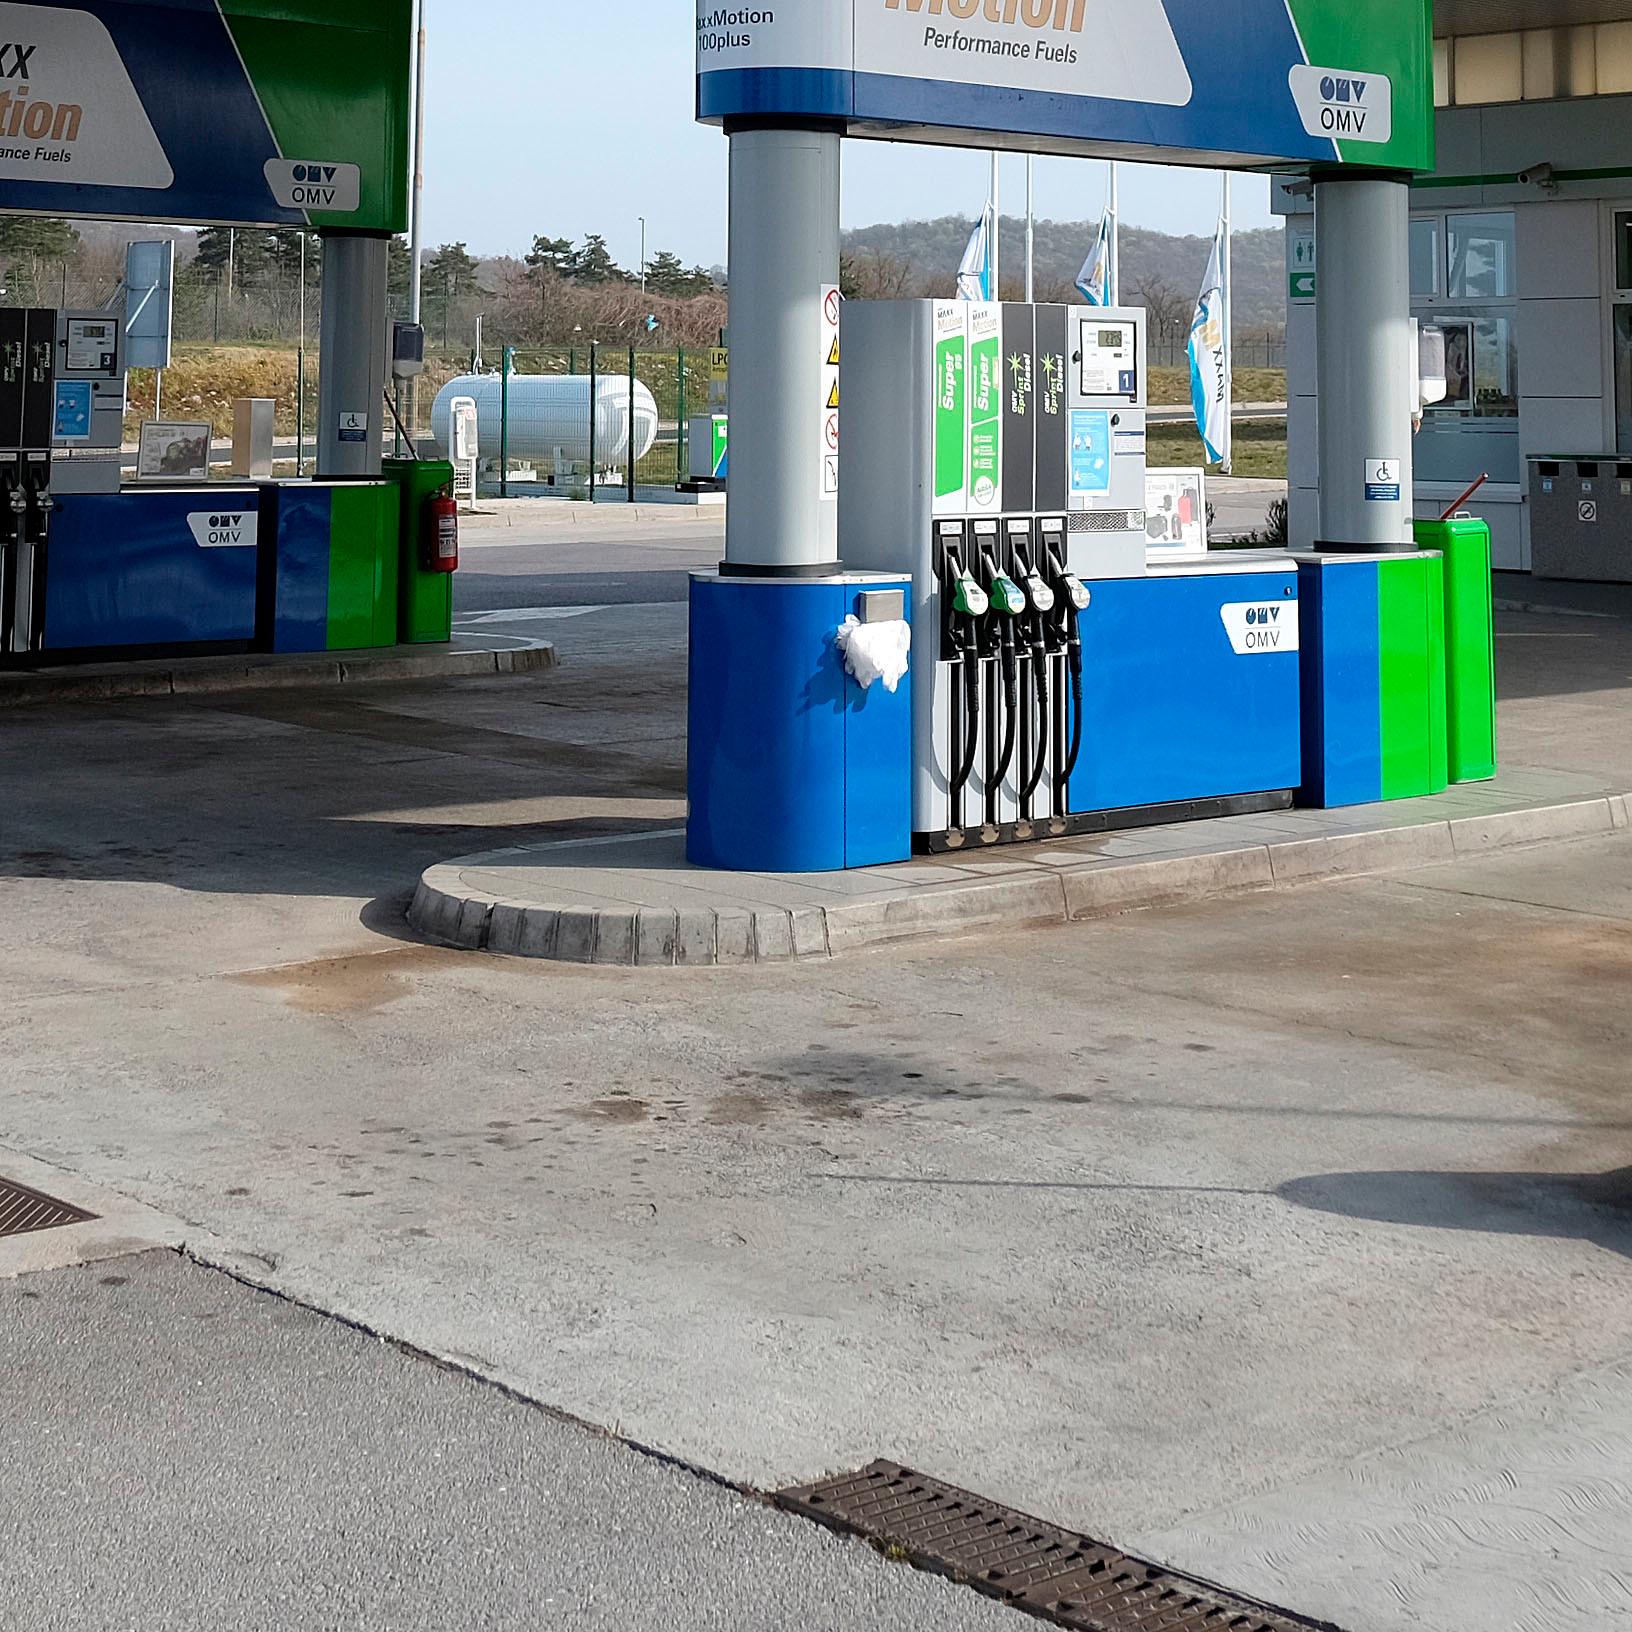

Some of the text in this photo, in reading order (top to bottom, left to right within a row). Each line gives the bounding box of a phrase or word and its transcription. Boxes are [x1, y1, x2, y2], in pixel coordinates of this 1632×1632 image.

[699, 31, 751, 53] 100plus
[924, 26, 1078, 64] Performance Fuels
[1320, 107, 1366, 133] OMV
[34, 147, 72, 163] Fuels
[292, 187, 335, 204] OMV
[103, 355, 111, 365] 3
[942, 351, 957, 410] Super
[977, 352, 991, 411] Super
[1023, 353, 1032, 392] Diesel
[1055, 354, 1064, 393] Diesel
[1122, 373, 1129, 388] 1
[1017, 376, 1026, 416] Sprint
[208, 530, 241, 543] OMV
[1245, 630, 1280, 648] OMV
